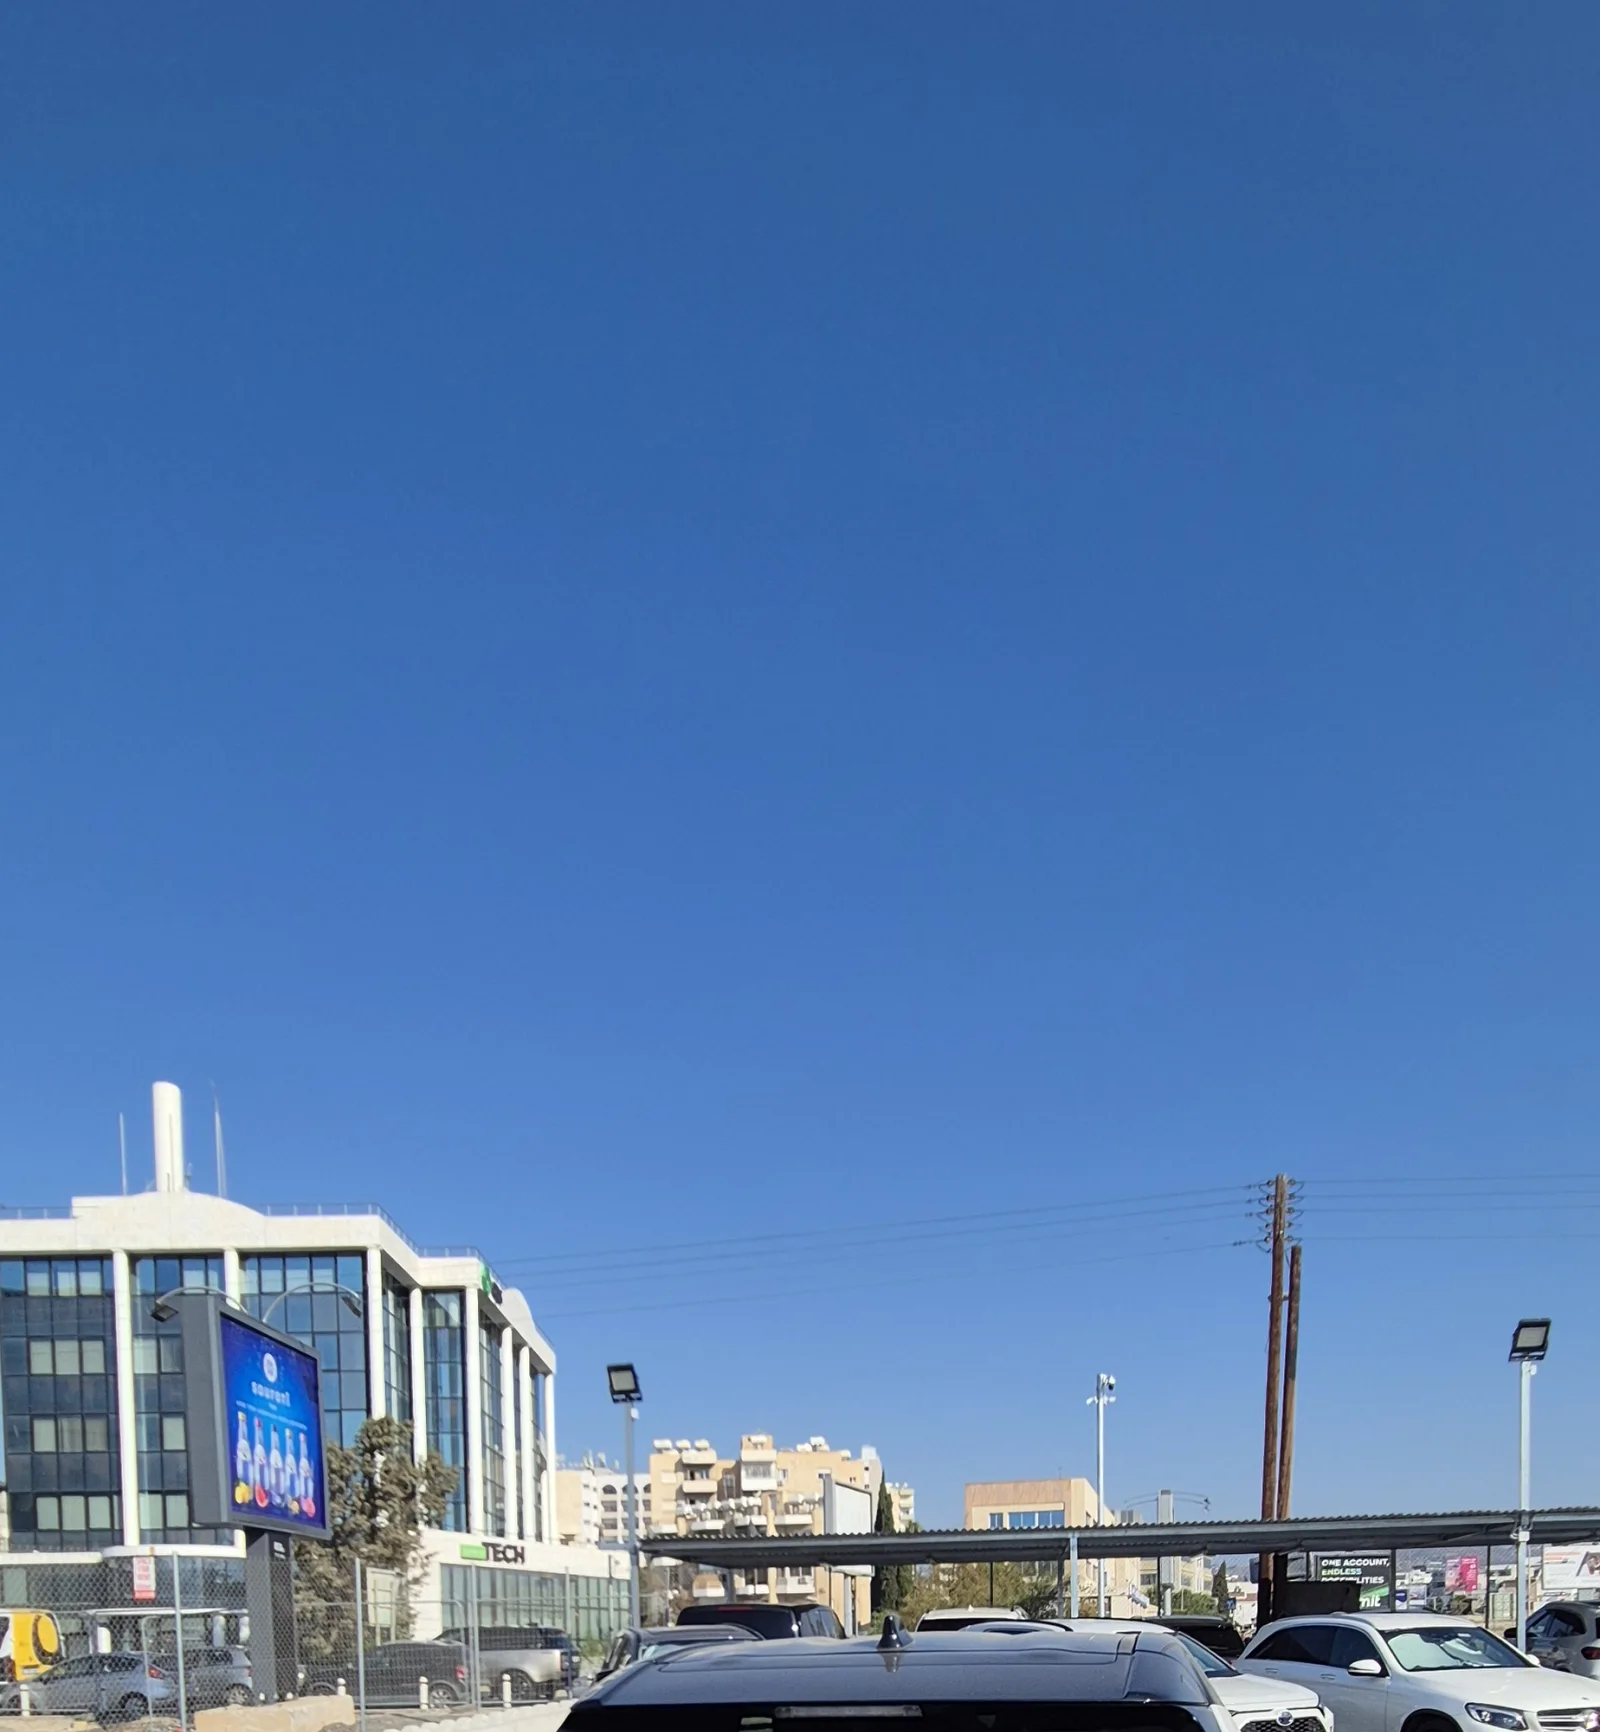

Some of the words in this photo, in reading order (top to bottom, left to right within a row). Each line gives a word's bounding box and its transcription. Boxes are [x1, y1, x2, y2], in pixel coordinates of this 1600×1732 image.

[482, 1542, 525, 1564] TECH
[1321, 1559, 1341, 1567] ONE
[1343, 1558, 1390, 1567] ACCOUNT,
[1321, 1568, 1362, 1576] ENDLESS
